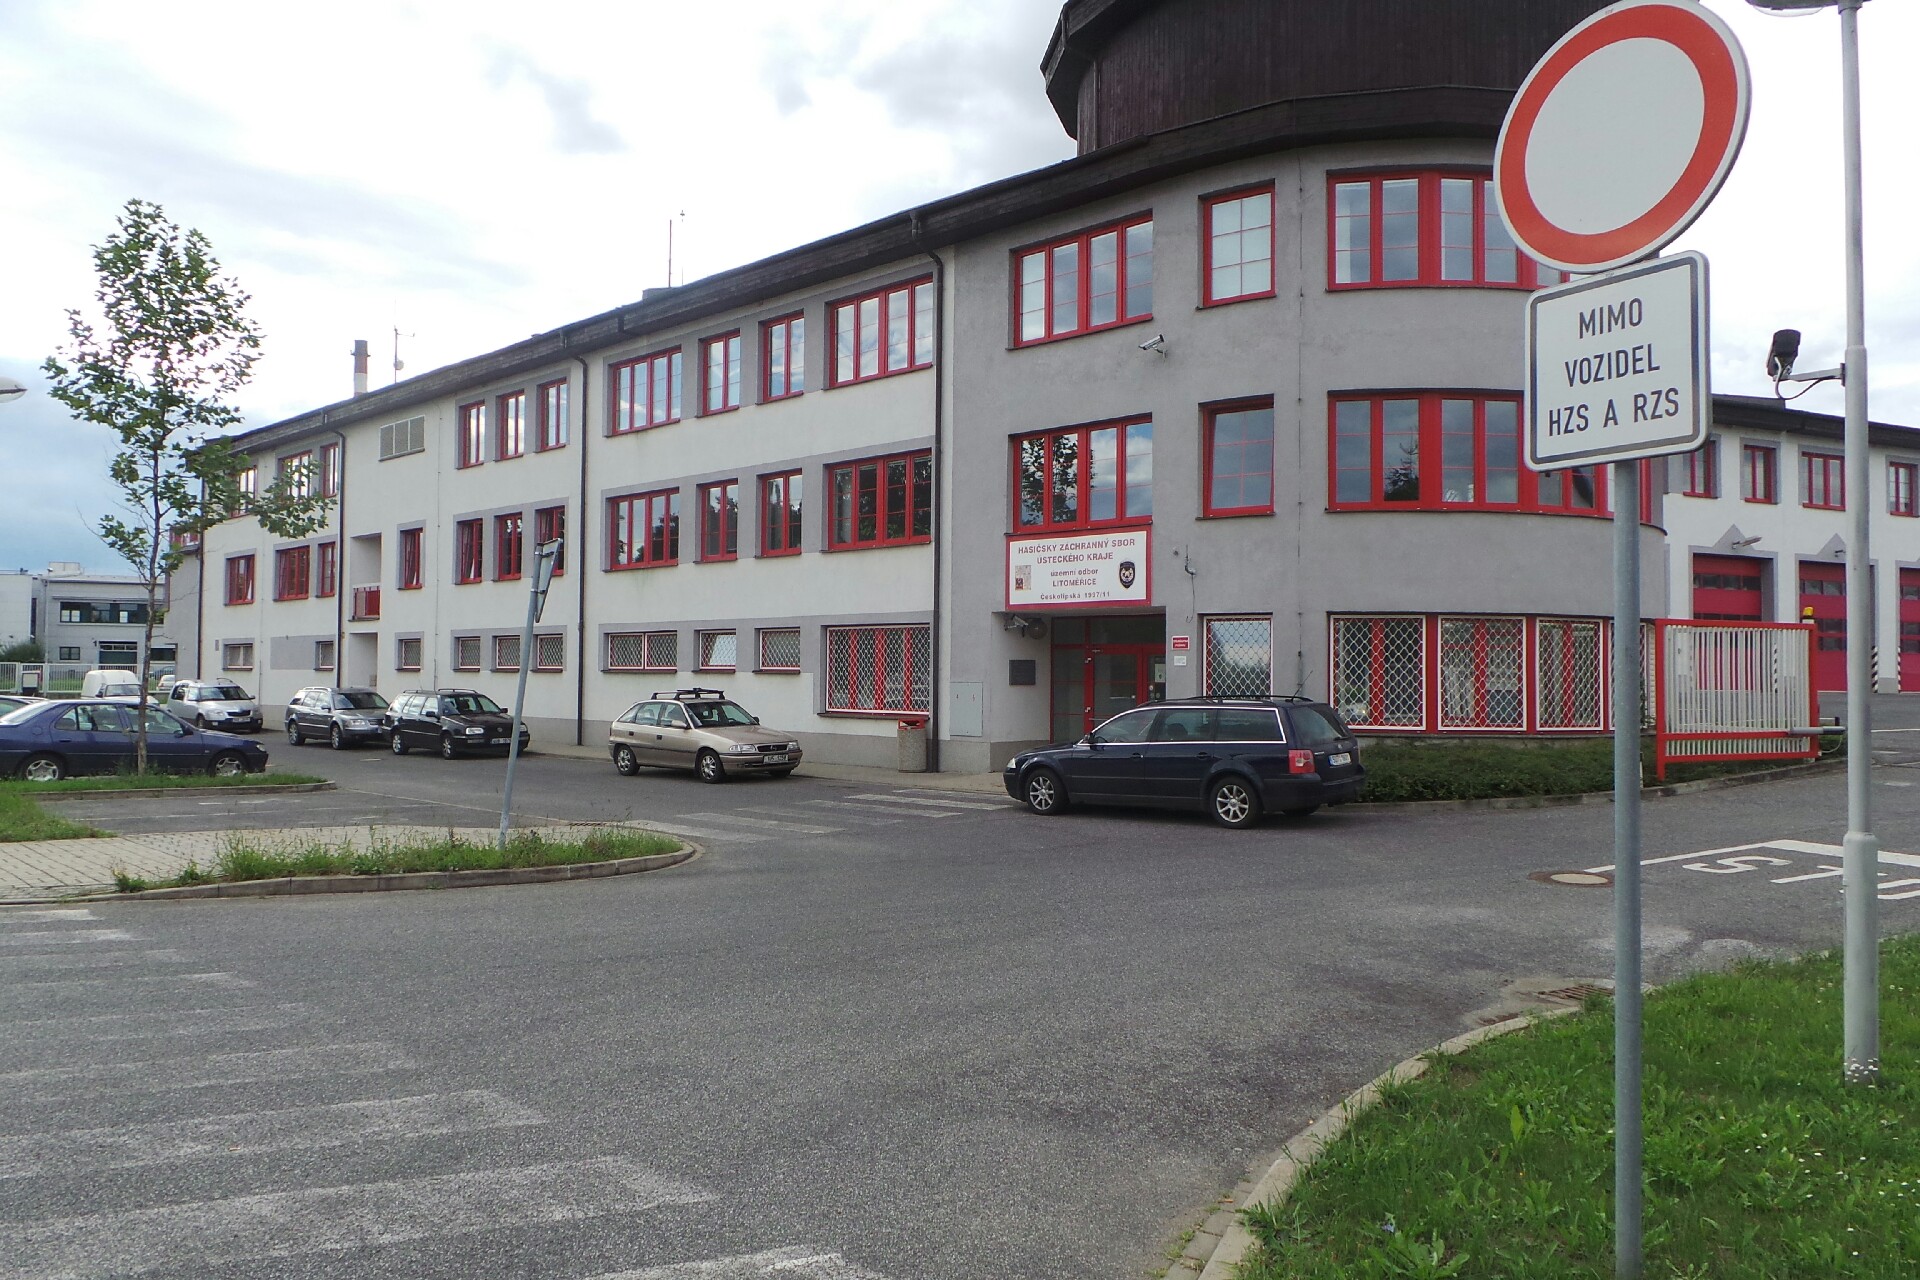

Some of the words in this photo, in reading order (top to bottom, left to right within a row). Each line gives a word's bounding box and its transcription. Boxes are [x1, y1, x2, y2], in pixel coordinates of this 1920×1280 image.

[1579, 297, 1643, 339] MIMO
[1564, 343, 1660, 387] VOZIDEL
[1549, 403, 1589, 437] HZS
[1603, 399, 1619, 428] A
[1633, 387, 1679, 423] RZS
[1059, 538, 1109, 551] ZÁCHRANNÝ
[1111, 538, 1135, 548] SBOR
[1037, 553, 1085, 564] ÚSTECKÉHO
[1087, 552, 1113, 561] KRAJE
[1078, 567, 1099, 576] odbor
[1052, 577, 1097, 587] LITOMĚŘICE
